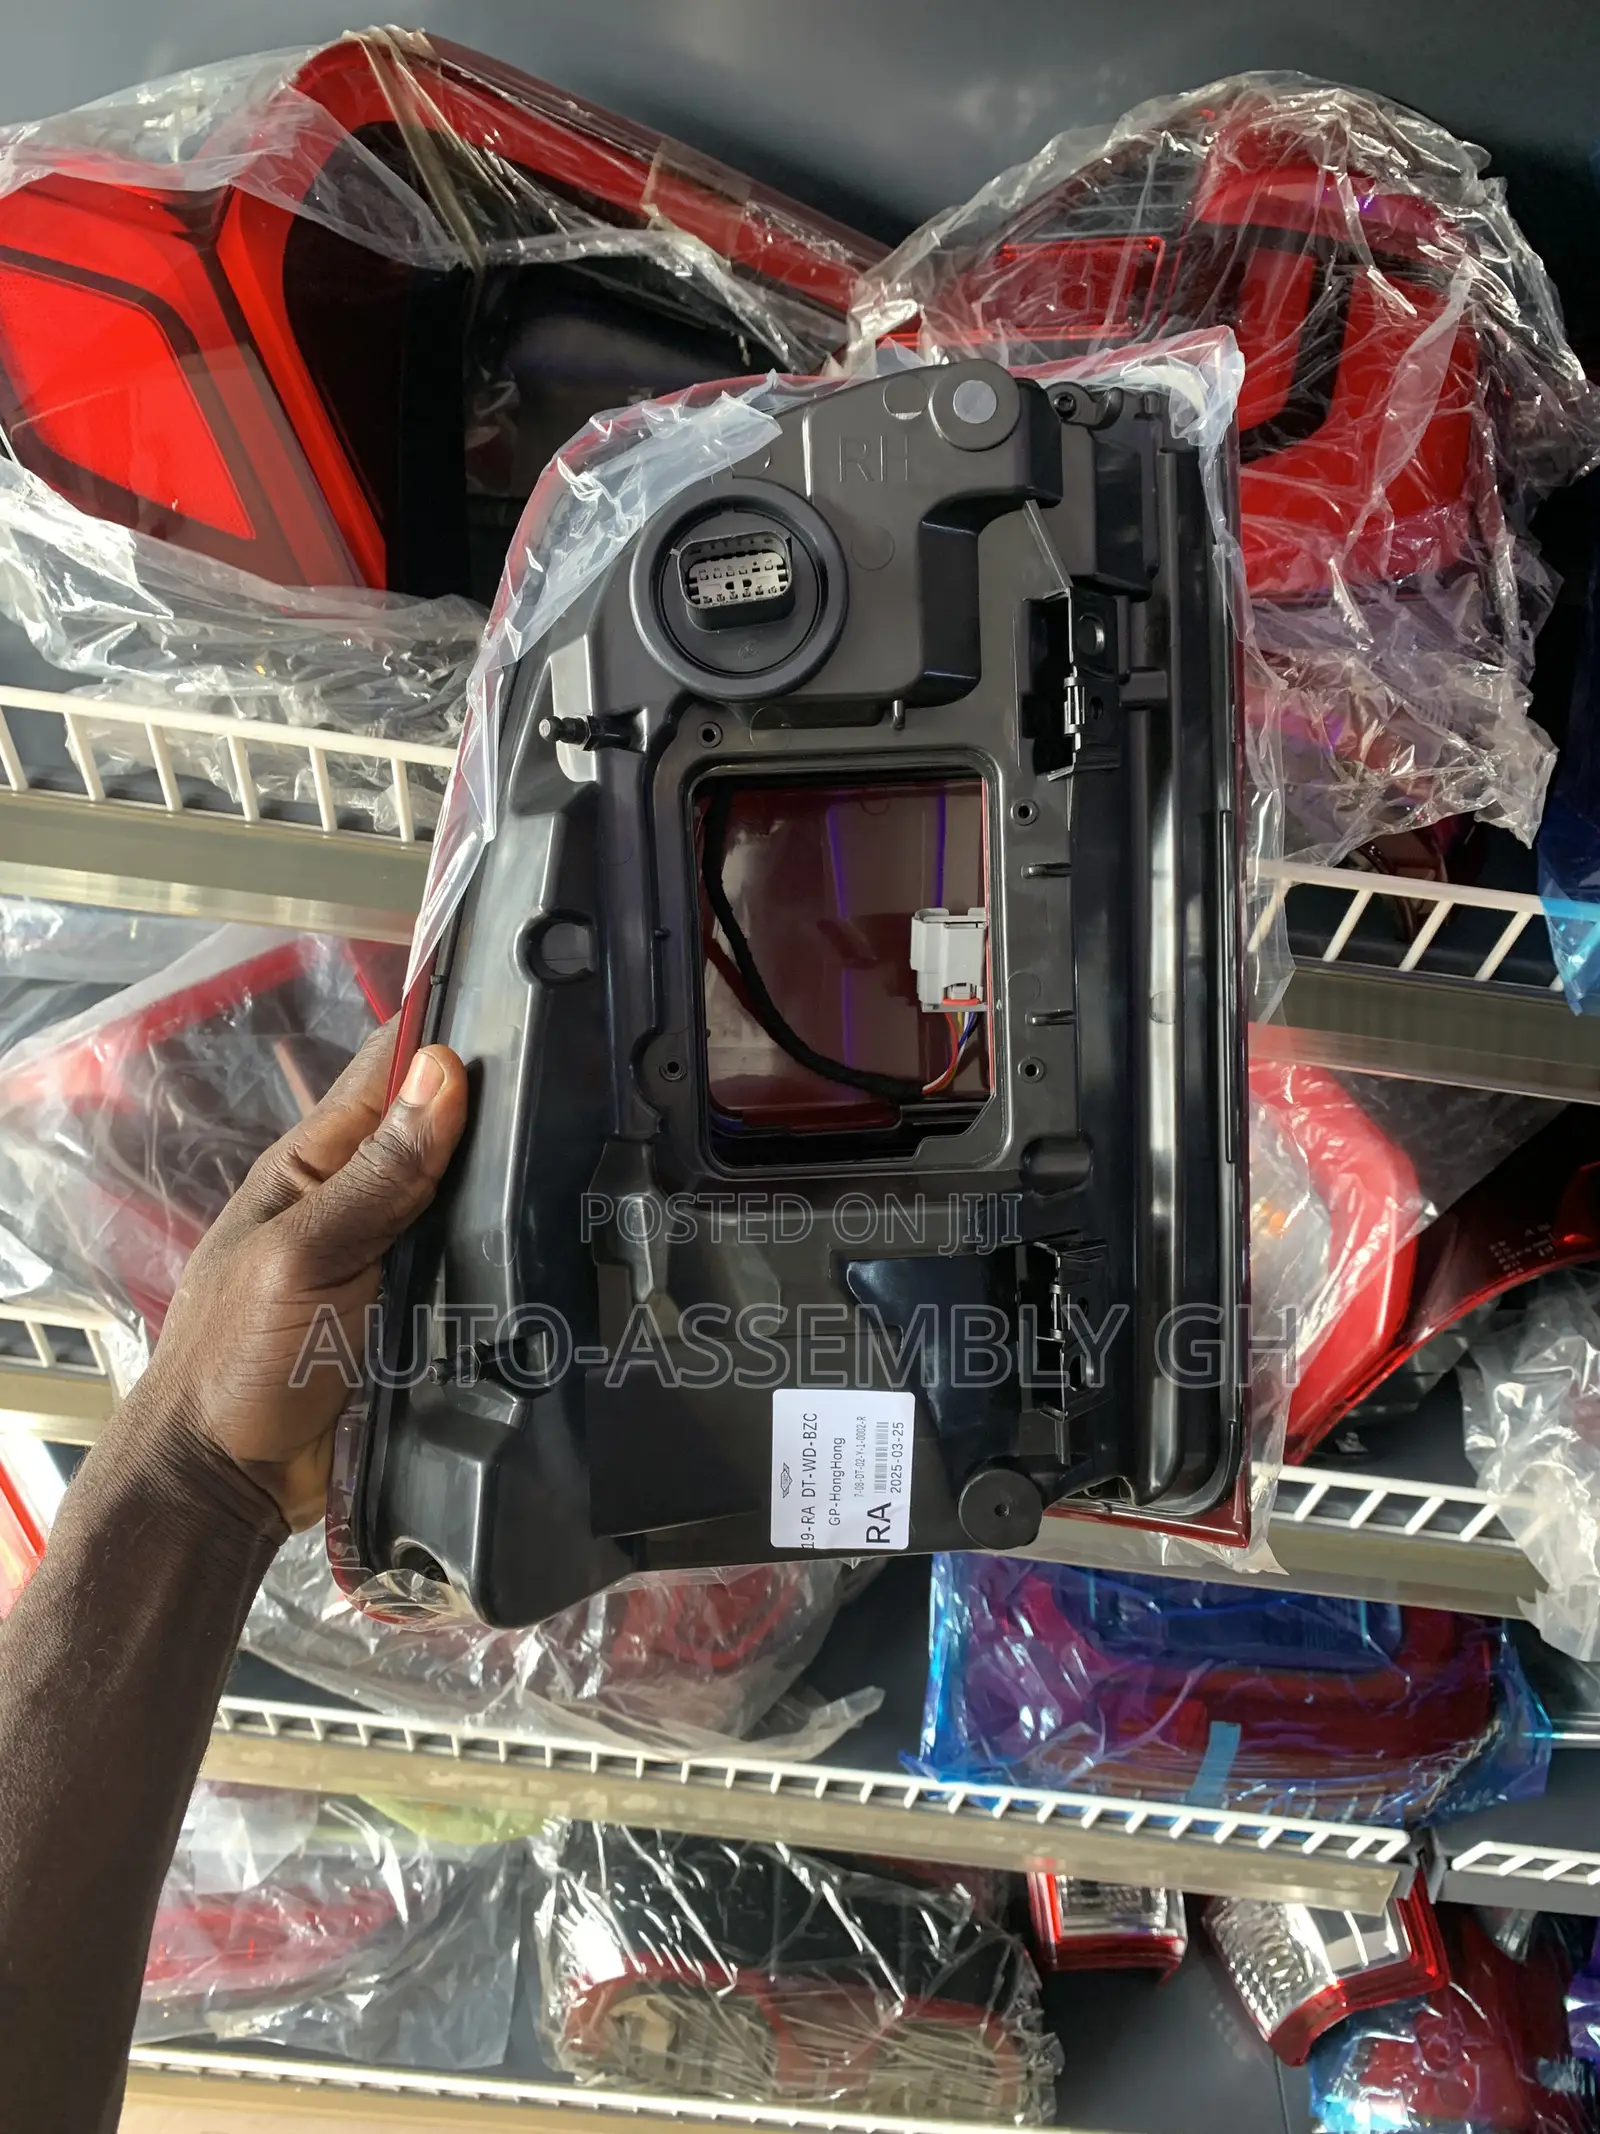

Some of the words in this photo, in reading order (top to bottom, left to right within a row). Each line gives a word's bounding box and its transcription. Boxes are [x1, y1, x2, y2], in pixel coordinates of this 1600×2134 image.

[839, 435, 911, 482] RH
[801, 1412, 818, 1498] DT-WD-BZC
[828, 1437, 846, 1526] GP-HongHong
[890, 1422, 904, 1494] 2025-03-25
[866, 1502, 892, 1544] RA
